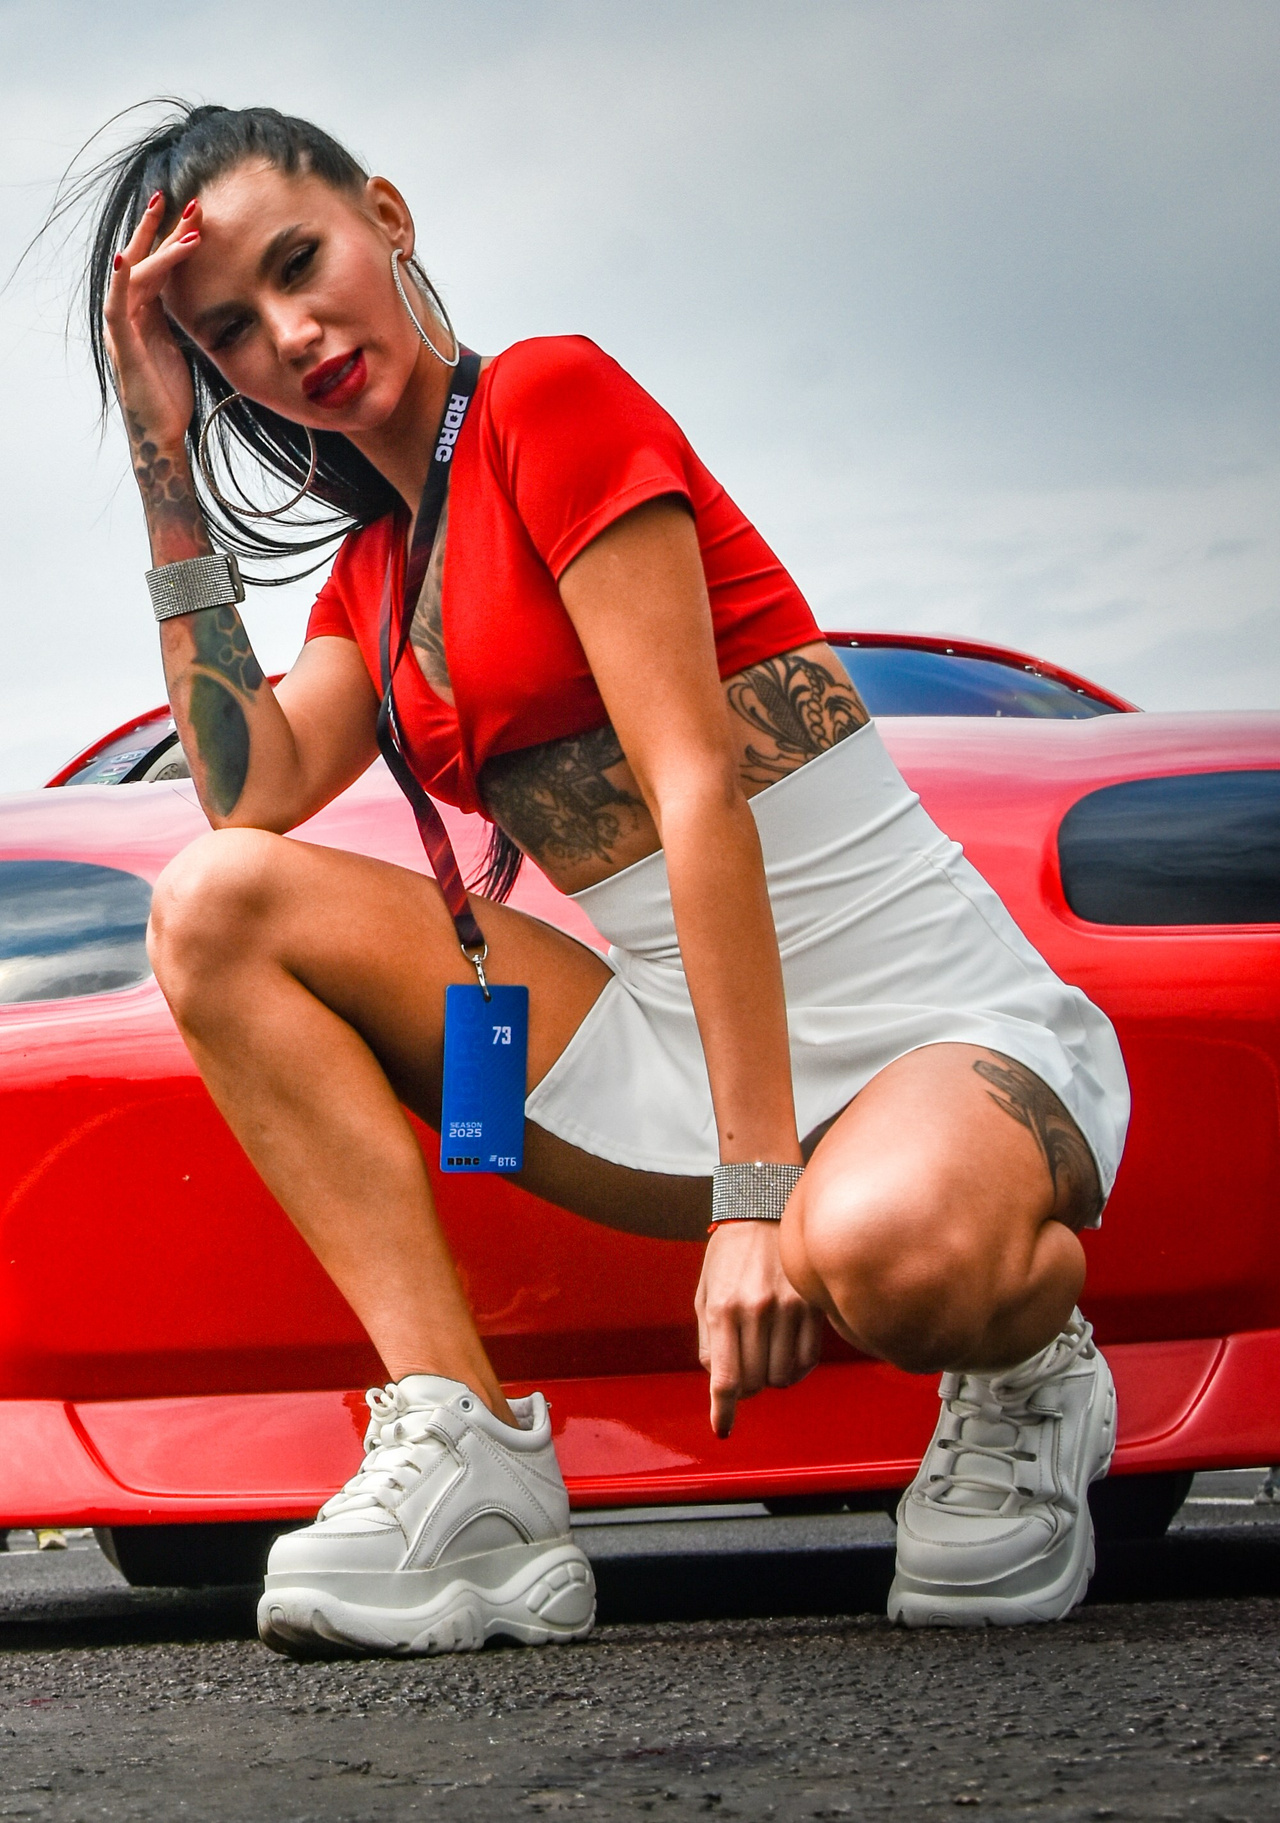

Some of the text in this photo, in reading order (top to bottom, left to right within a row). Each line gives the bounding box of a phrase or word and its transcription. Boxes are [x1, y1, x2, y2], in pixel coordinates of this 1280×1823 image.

[435, 393, 469, 463] RDRC
[492, 1026, 512, 1045] 73
[449, 1129, 482, 1138] 2025
[447, 1157, 480, 1166] RDRC
[497, 1156, 517, 1167] ВТБ
